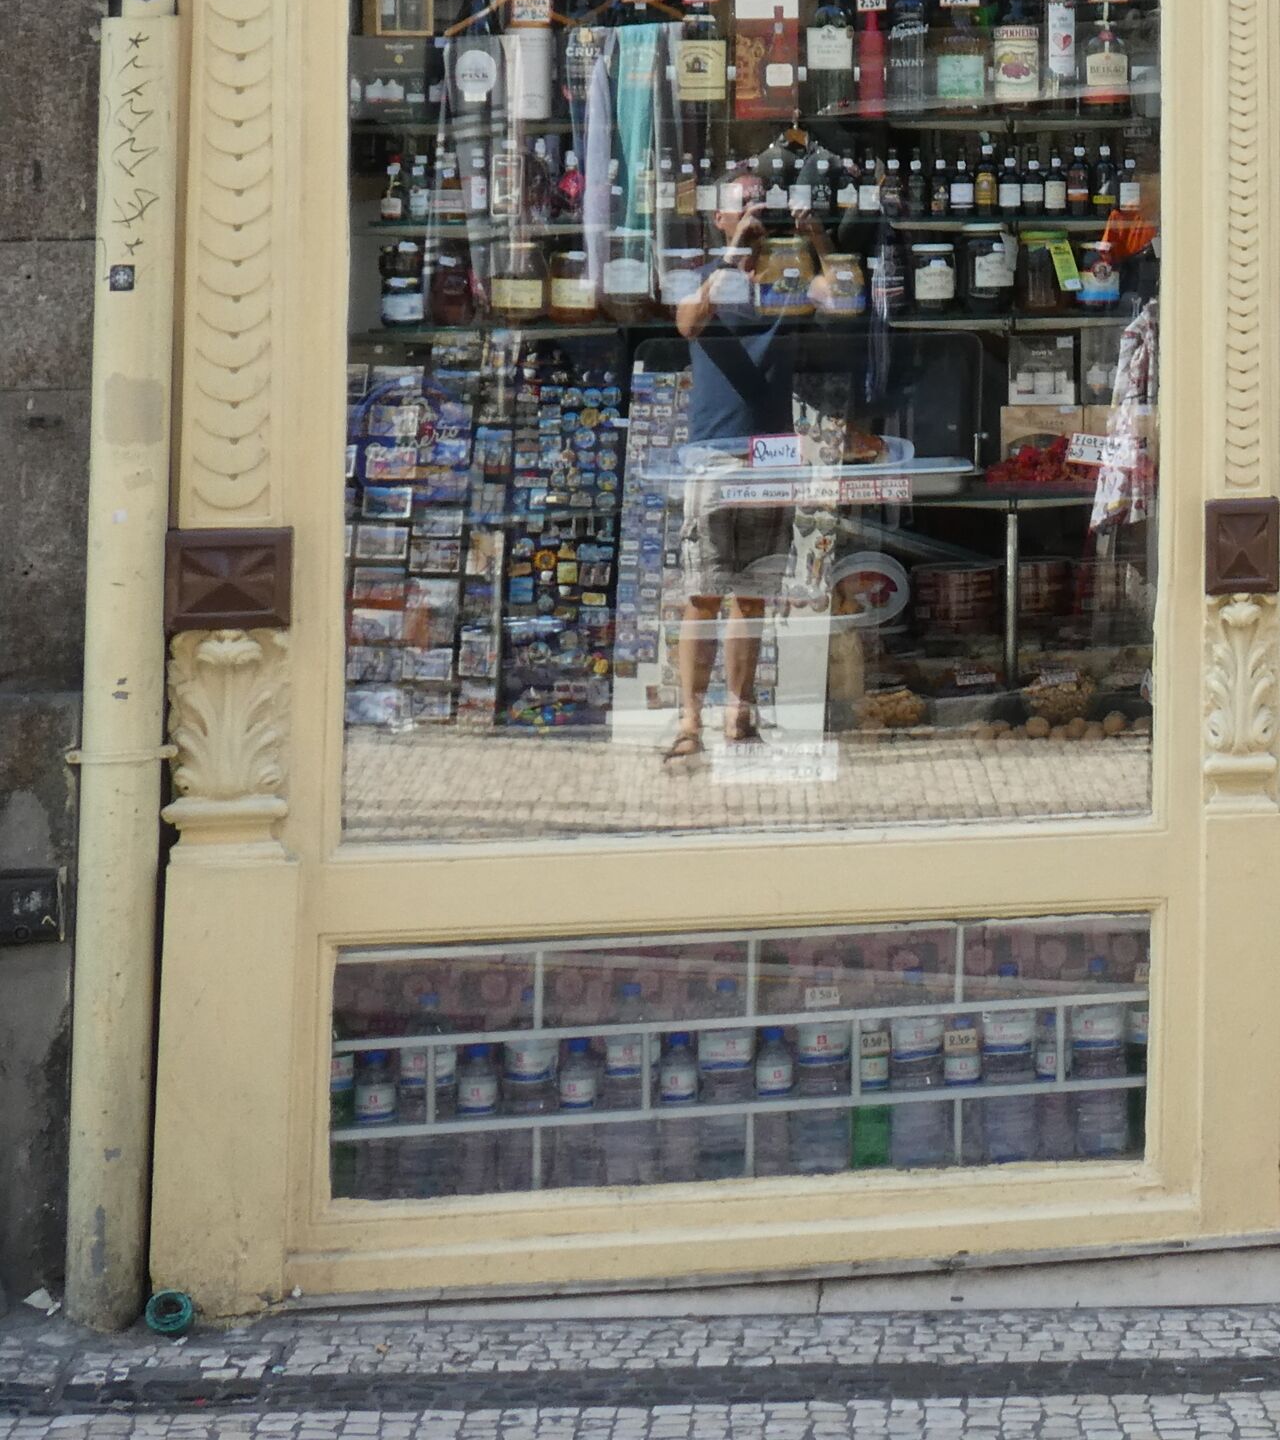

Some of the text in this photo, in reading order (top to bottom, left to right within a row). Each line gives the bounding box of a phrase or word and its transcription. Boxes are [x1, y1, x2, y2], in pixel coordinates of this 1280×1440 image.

[565, 46, 601, 57] CRUZ
[890, 58, 925, 68] TAWNY
[720, 485, 757, 499] LEITÃO
